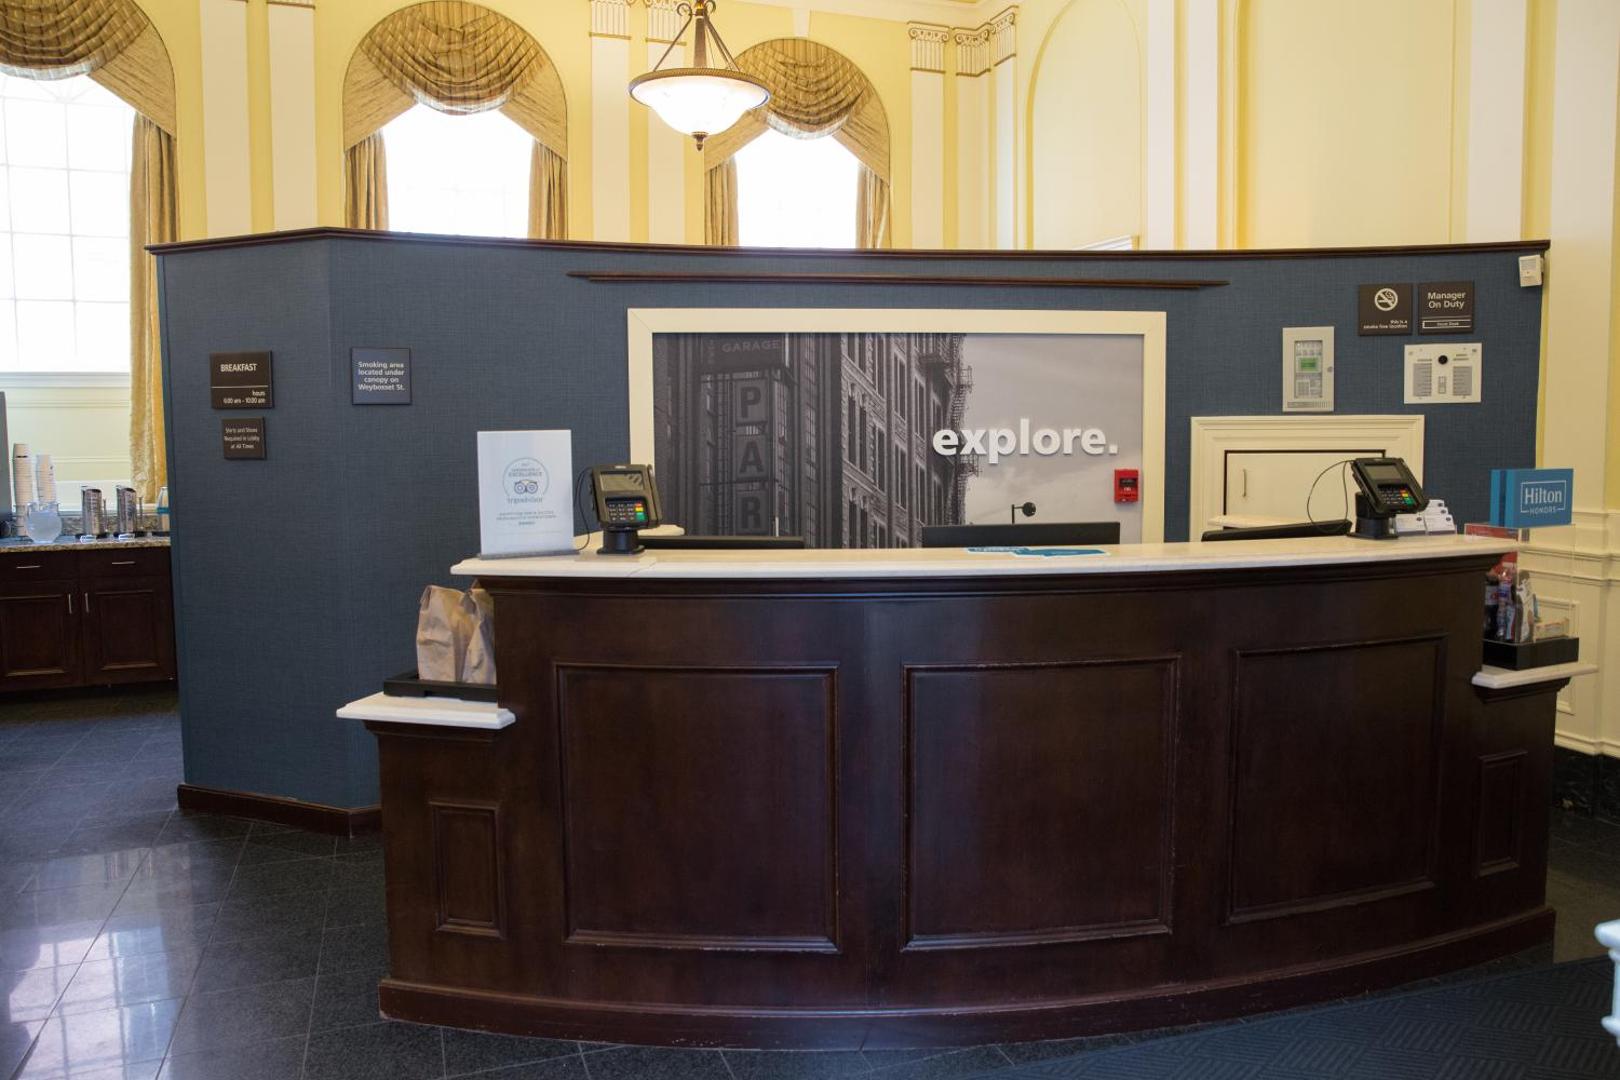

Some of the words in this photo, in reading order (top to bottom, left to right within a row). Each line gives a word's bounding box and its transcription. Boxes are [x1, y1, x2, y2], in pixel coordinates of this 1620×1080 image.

[1427, 292, 1466, 302] Manager
[1428, 300, 1441, 309] On
[1443, 299, 1465, 310] Duty
[722, 339, 781, 353] GARAGE
[220, 363, 258, 373] BREAKFAST
[358, 361, 388, 369] Smoking
[358, 384, 395, 392] Weybosset
[933, 418, 1119, 465] explore.
[1525, 487, 1562, 504] Hilton
[1530, 507, 1557, 515] HONORS
